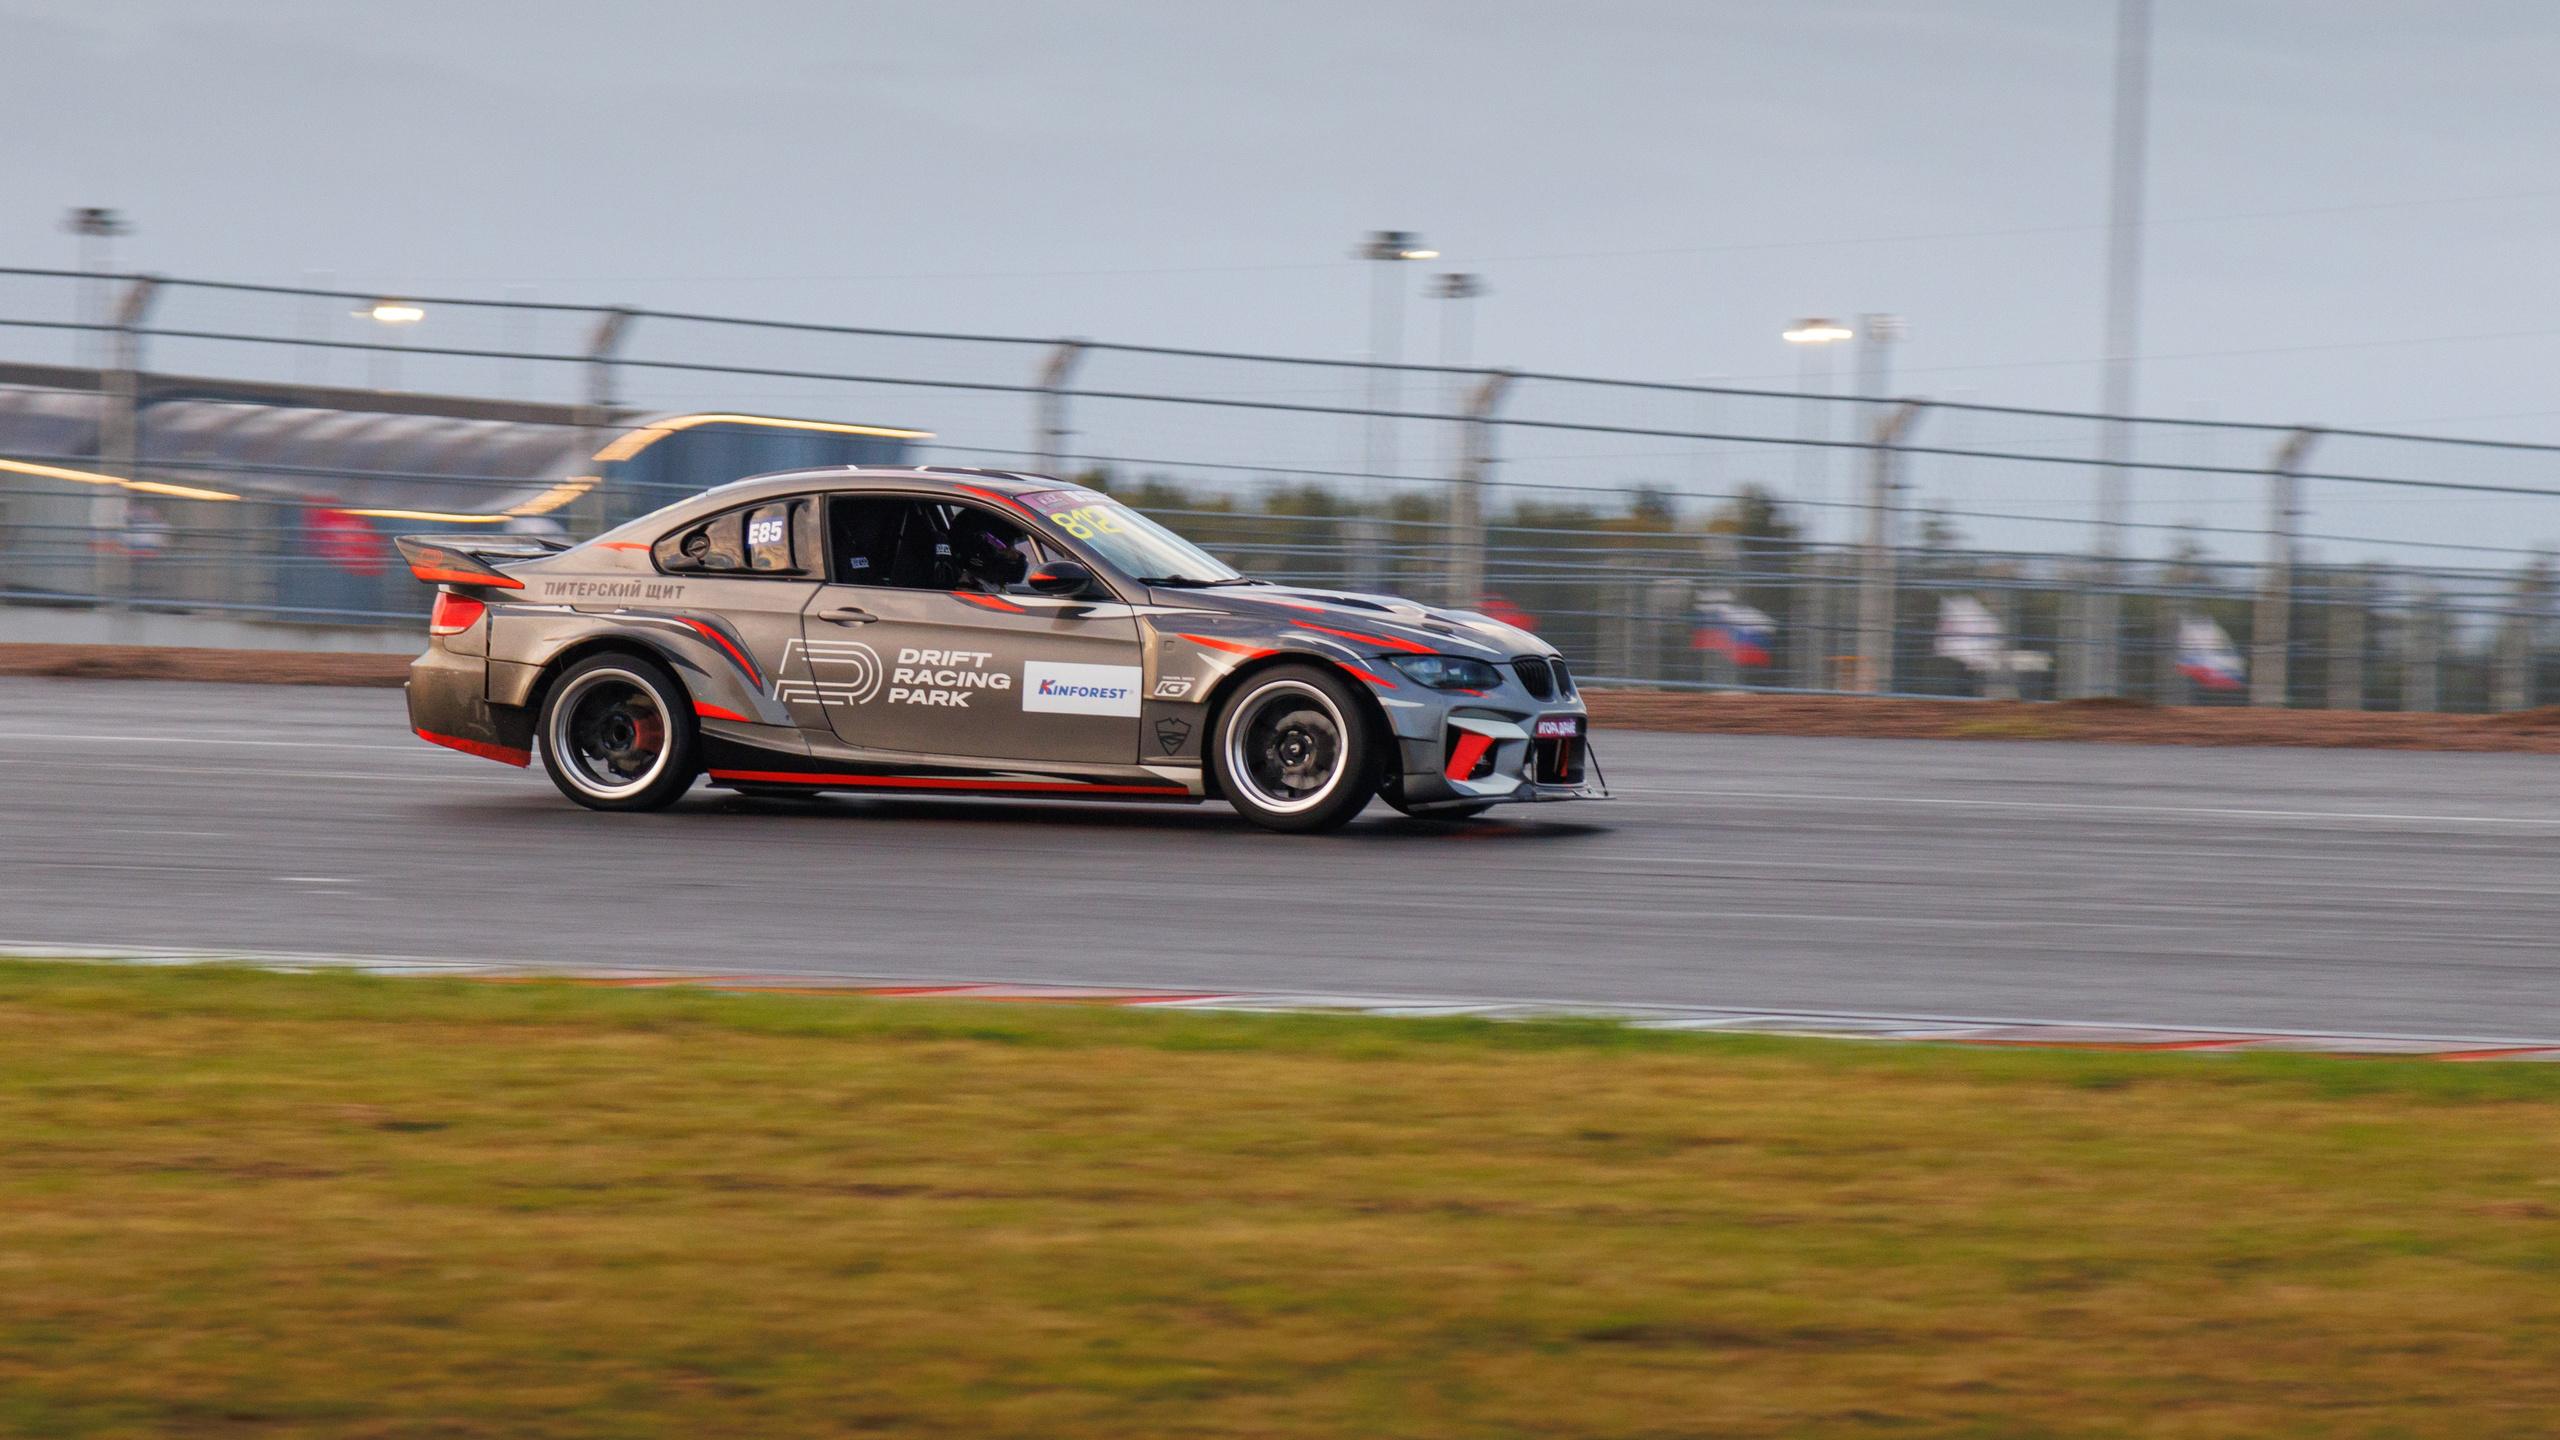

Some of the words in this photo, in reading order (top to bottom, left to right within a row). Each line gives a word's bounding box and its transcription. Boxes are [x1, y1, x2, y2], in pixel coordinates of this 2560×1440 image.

[748, 520, 783, 545] E85
[1050, 508, 1124, 539] 812
[544, 579, 641, 598] ПИТЕРСКИЙ
[645, 584, 686, 600] ЩИТ
[897, 648, 993, 668] DRIFT
[892, 667, 1012, 690] RACING
[1038, 679, 1128, 699] KINFOREST
[888, 687, 973, 708] PARK
